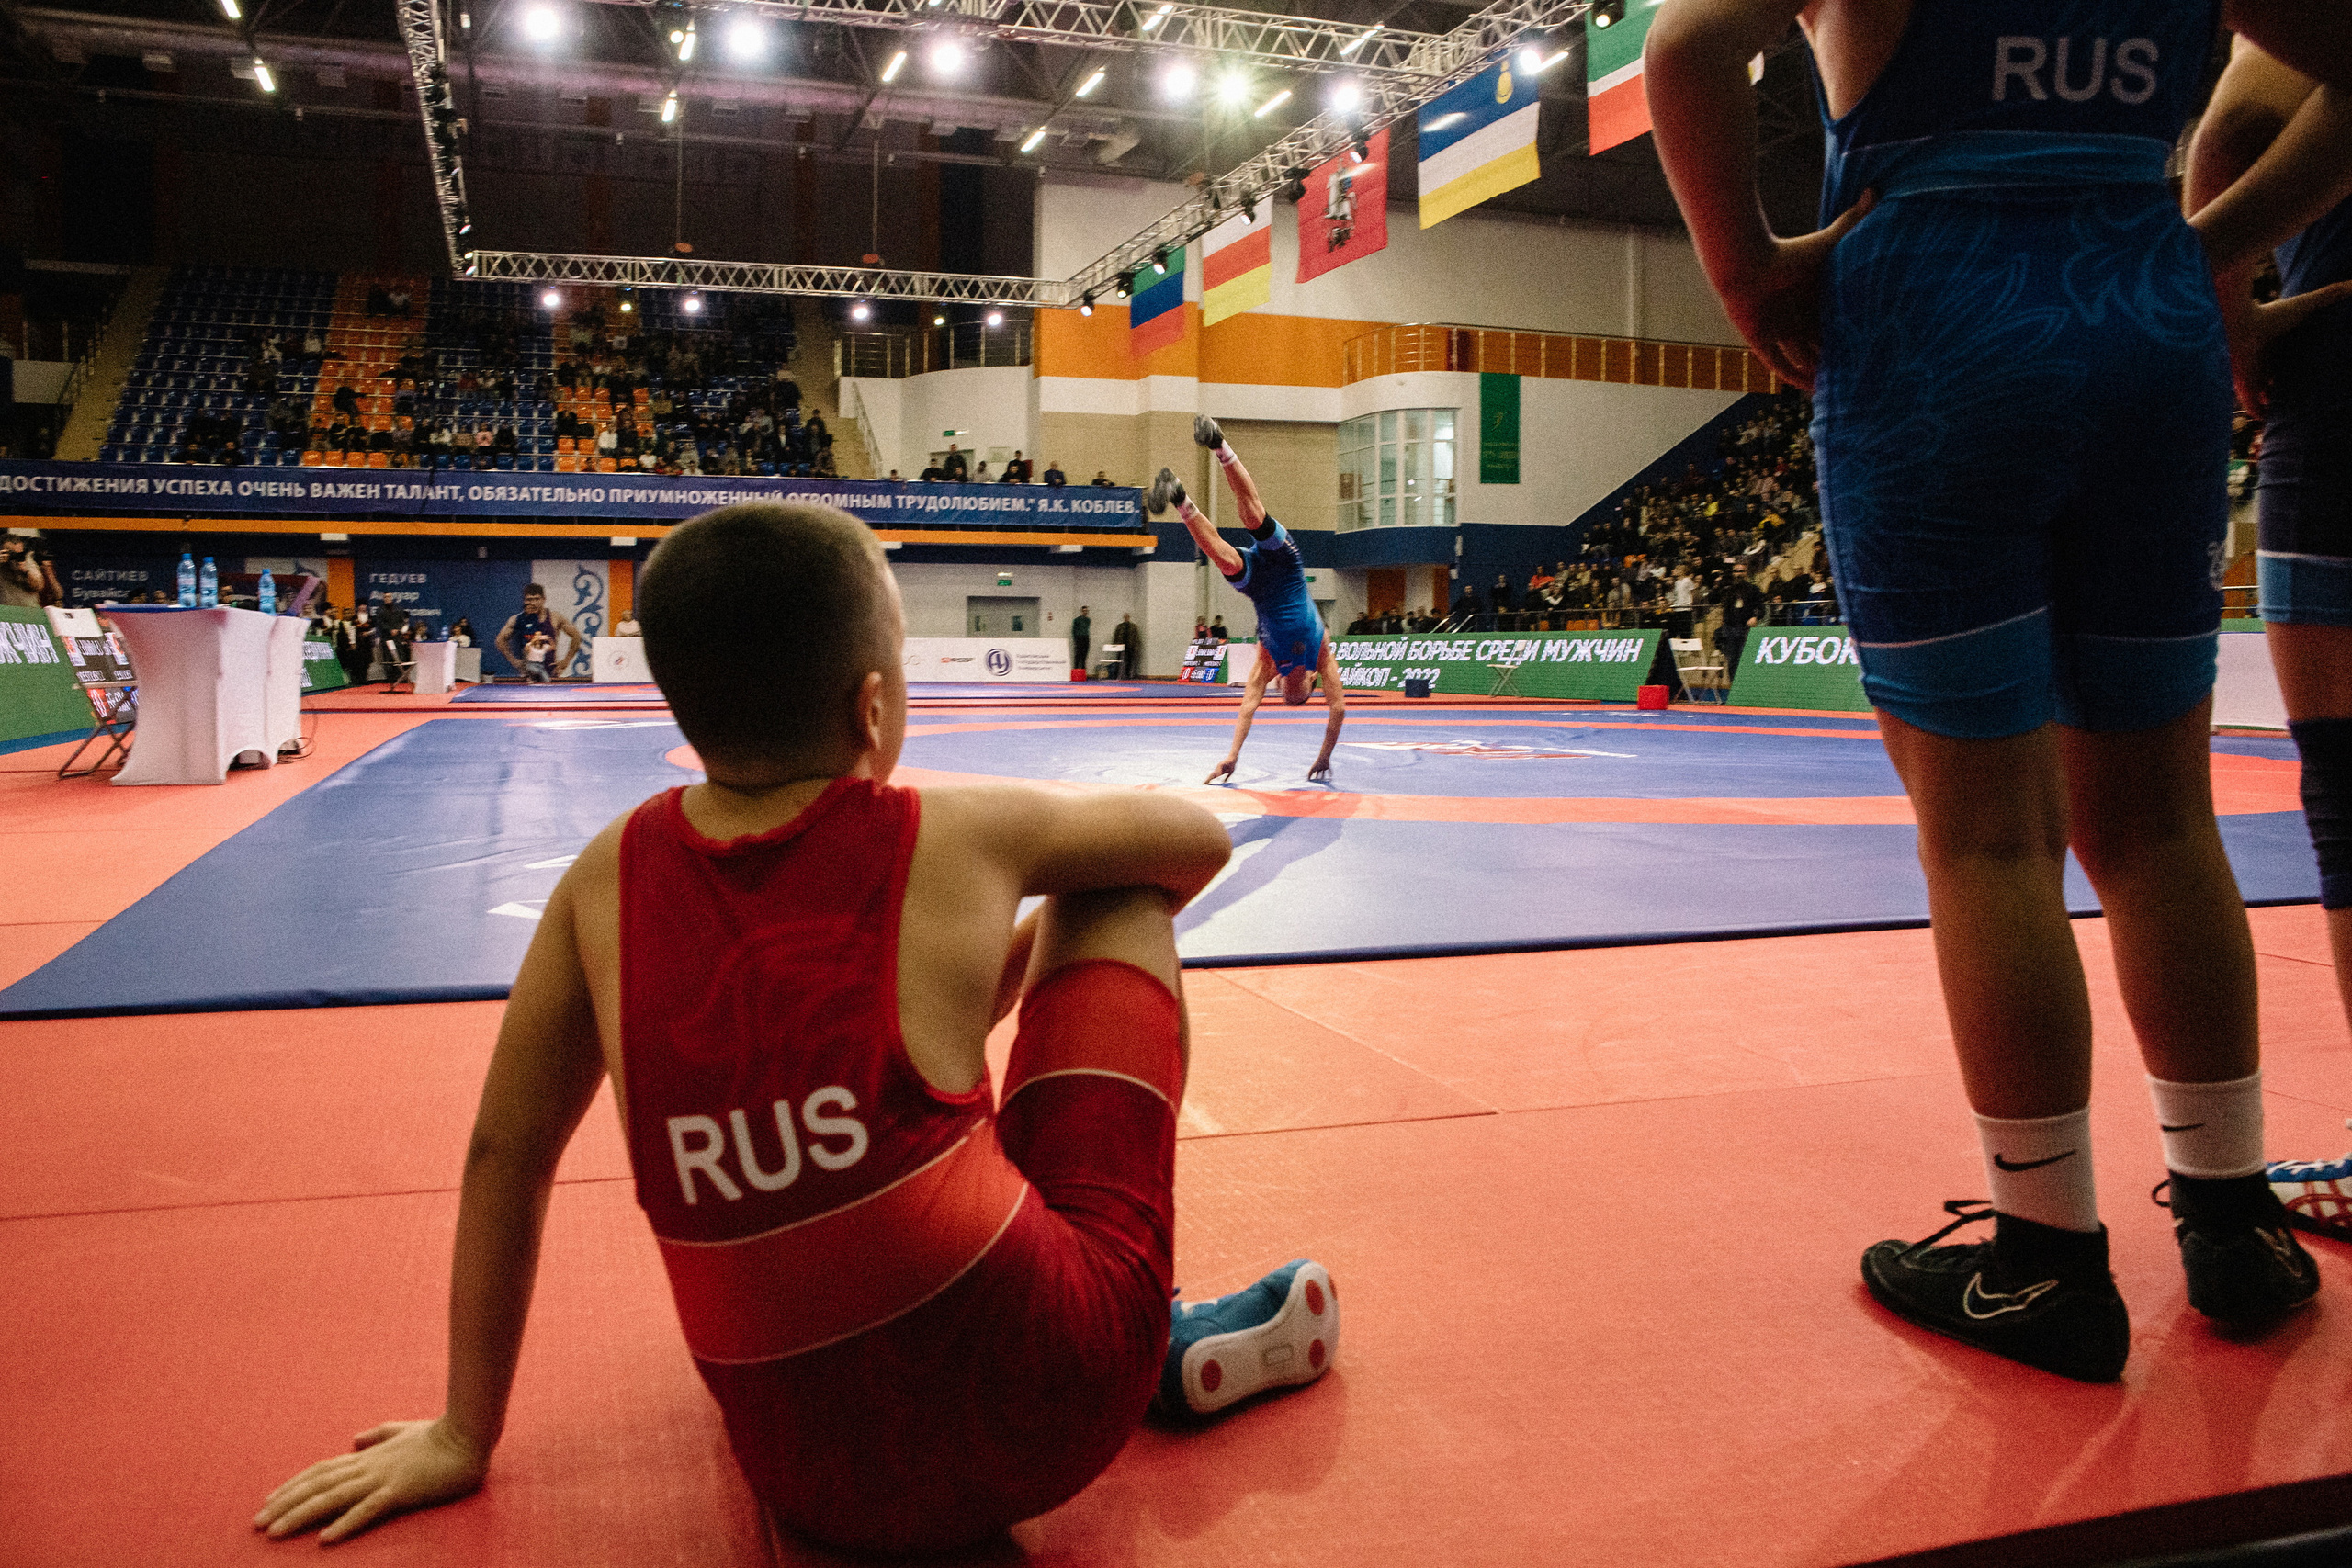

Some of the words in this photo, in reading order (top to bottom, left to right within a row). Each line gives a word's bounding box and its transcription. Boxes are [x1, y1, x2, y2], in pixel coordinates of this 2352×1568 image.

[1992, 36, 2160, 105] RUS
[0, 475, 148, 494] ДОСТИЖЕНИЯ
[152, 479, 233, 496] УСПЕХА
[237, 480, 306, 498] ОЧЕНЬ
[311, 483, 380, 499] ВАЖЕН
[384, 484, 464, 502] ТАЛАНТ,
[468, 485, 605, 503] ОБЯЗАТЕЛЬНО
[1037, 498, 1069, 513] Я.К.
[1071, 499, 1140, 514] КОБЛЕВ.
[72, 568, 150, 581] САЙТИЕВ
[369, 573, 427, 585] ГЕДУЕВ
[1335, 636, 1409, 660] ВОЛЬНОЙ
[1406, 639, 1476, 660] БОРЬБЕ
[1539, 638, 1644, 663] МУЖЧИН
[1754, 637, 1860, 665] КУБОК
[666, 1085, 869, 1205] RUS
